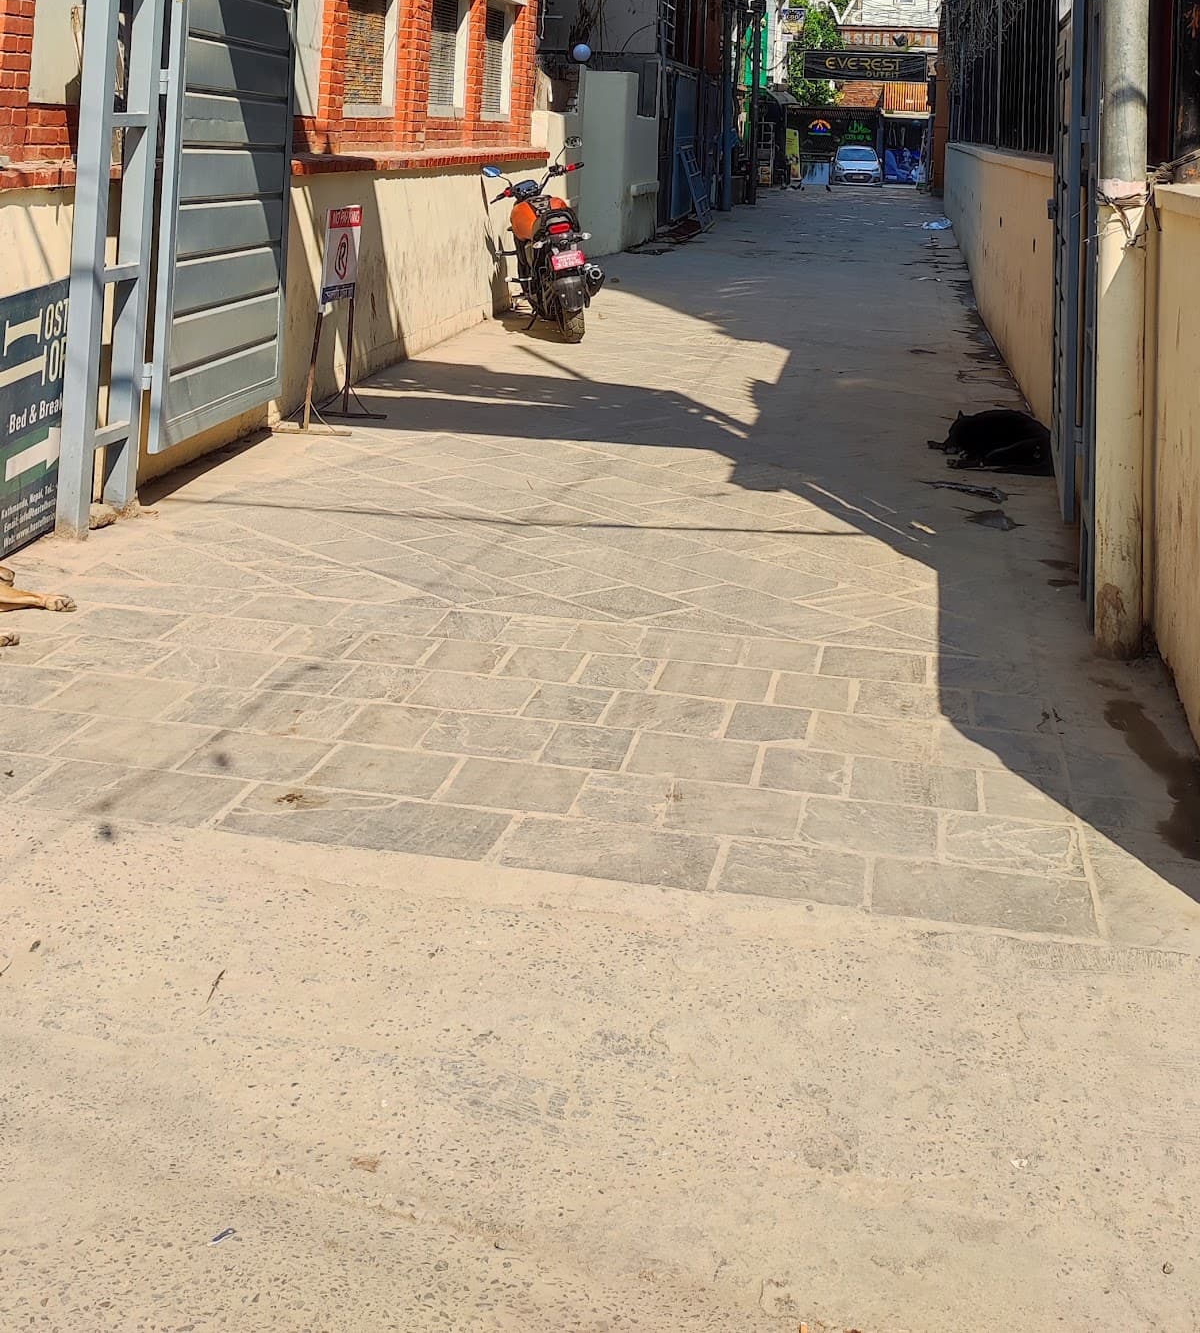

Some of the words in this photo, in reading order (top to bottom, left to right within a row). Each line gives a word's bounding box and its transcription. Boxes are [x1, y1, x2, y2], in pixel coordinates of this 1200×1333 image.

[825, 56, 904, 72] EVEREST
[865, 70, 901, 79] OUTFIT
[8, 407, 28, 435] Bed
[29, 403, 38, 425] &
